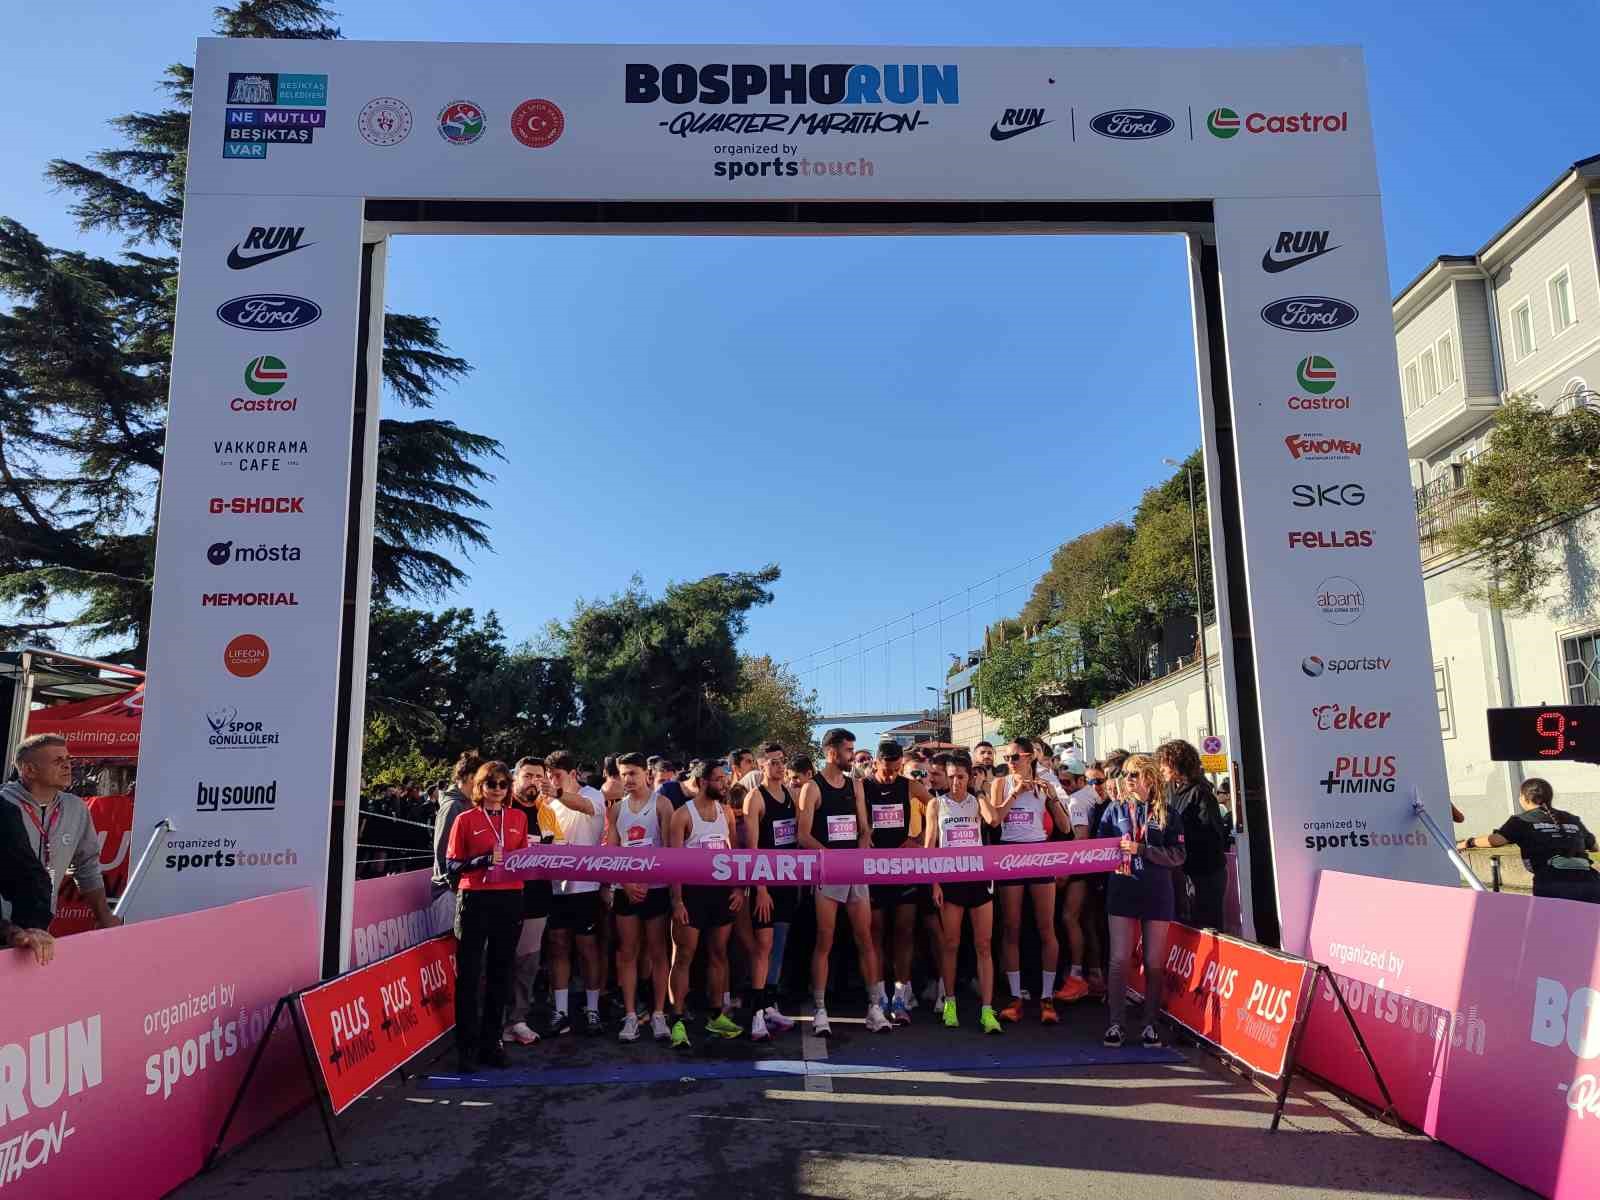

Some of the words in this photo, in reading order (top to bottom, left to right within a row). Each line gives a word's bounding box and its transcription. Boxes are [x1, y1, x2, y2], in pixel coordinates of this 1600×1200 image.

[625, 64, 960, 105] BOSPHORUN
[231, 112, 254, 123] NE
[264, 112, 320, 124] MUTLU
[1000, 109, 1044, 127] RUN
[1107, 113, 1157, 134] Ford
[1245, 112, 1348, 133] Castrol
[230, 128, 309, 142] BEŞİKTAŞ
[230, 144, 262, 156] VAR
[713, 143, 778, 155] organized
[782, 143, 798, 156] by
[243, 227, 305, 249] RUN
[1274, 231, 1329, 252] RUN
[238, 300, 301, 324] Ford
[1280, 302, 1339, 326] Ford
[230, 397, 298, 412] Castrol
[1287, 396, 1350, 410] Castrol
[214, 441, 308, 454] VAKKORAMA
[239, 459, 281, 471] CAFE
[209, 497, 305, 514] G-SHOCK
[1292, 484, 1366, 507] SKG
[235, 544, 301, 562] mösta
[202, 592, 299, 607] MEMORIAL
[1316, 591, 1361, 607] abant
[228, 722, 263, 732] SPOR
[1336, 756, 1396, 777] PLUS
[1303, 820, 1352, 831] organized
[1355, 820, 1367, 831] by
[167, 838, 221, 850] organized
[223, 838, 237, 850] by
[712, 854, 817, 881] START
[863, 855, 984, 875] BOSPHORUN
[1166, 944, 1196, 979] PLUS
[1328, 940, 1385, 969] organized
[1388, 956, 1405, 978] by
[420, 959, 447, 996] PLUS
[1203, 960, 1239, 999] PLUS
[380, 976, 412, 1017] PLUS
[1247, 979, 1292, 1024] PLUS
[143, 987, 216, 1035] organized
[219, 983, 236, 1007] by
[330, 996, 370, 1047] PLUS
